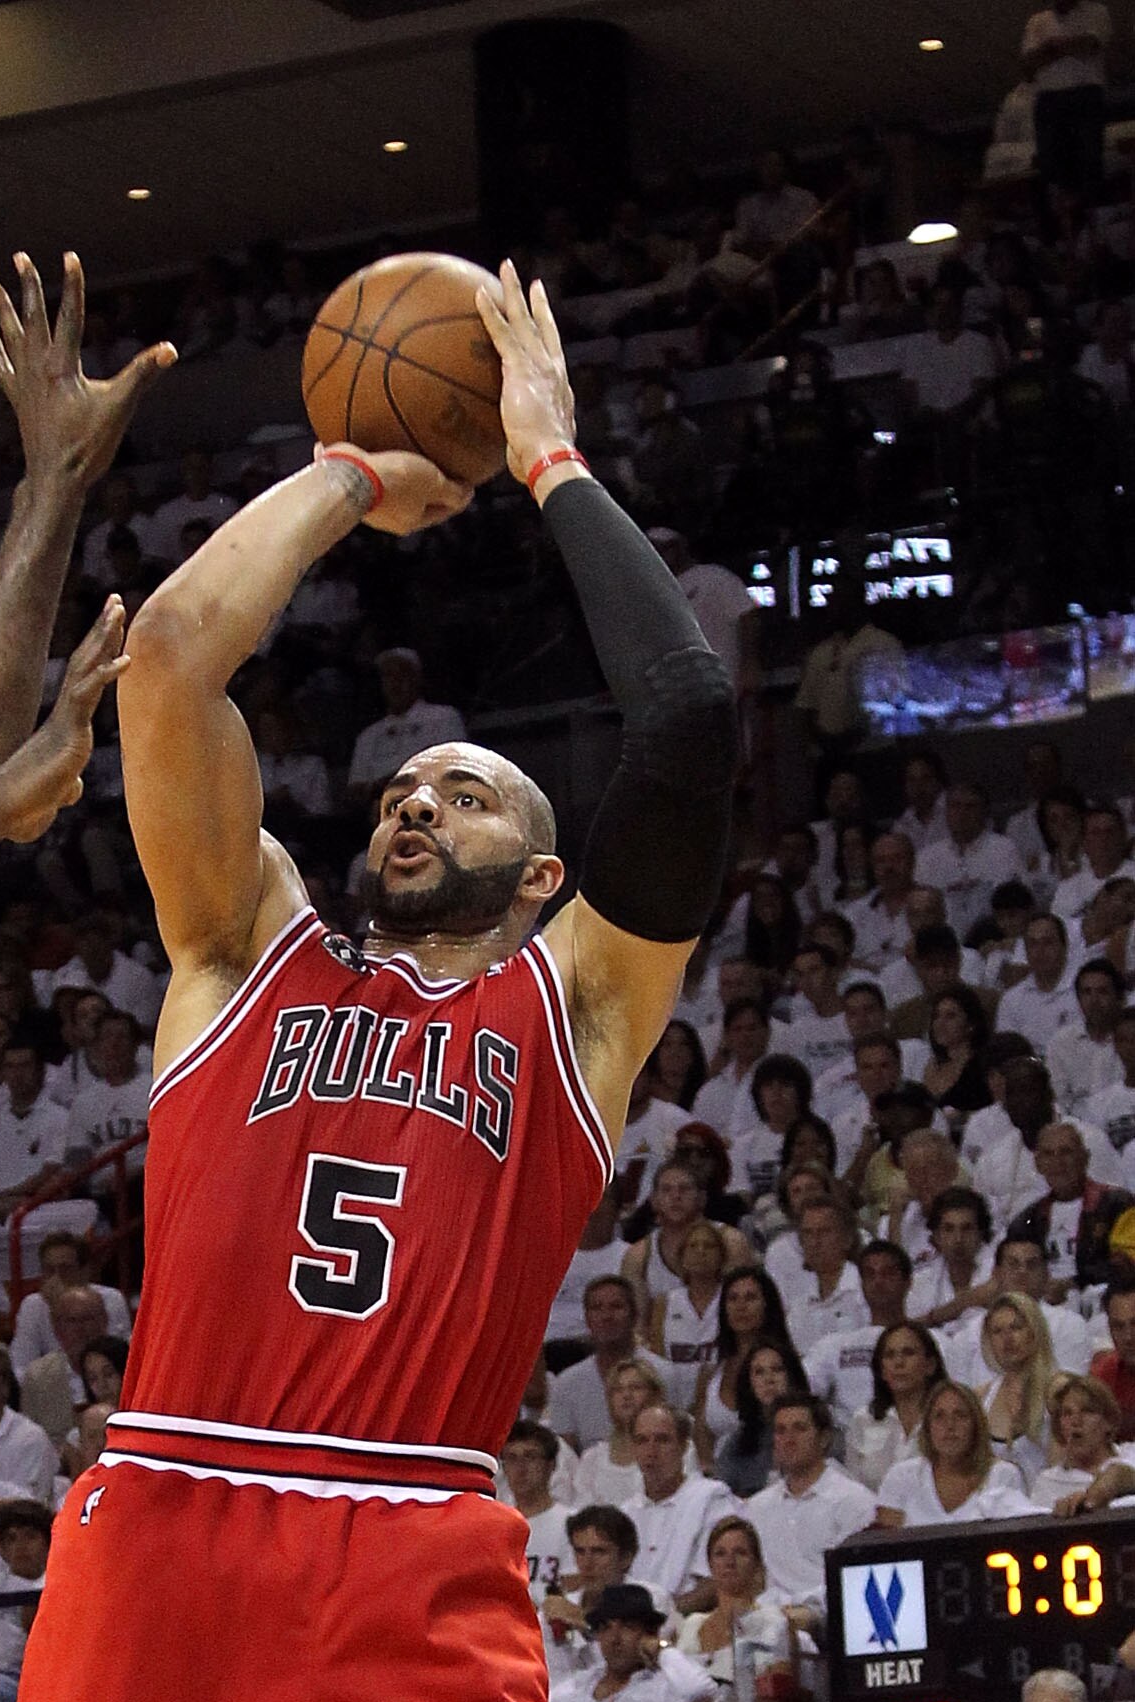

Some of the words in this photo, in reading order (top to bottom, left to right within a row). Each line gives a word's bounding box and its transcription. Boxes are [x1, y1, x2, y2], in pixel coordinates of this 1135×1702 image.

[246, 1005, 518, 1163] BULLS
[288, 1153, 408, 1321] 5
[866, 1658, 924, 1689] HEAT
